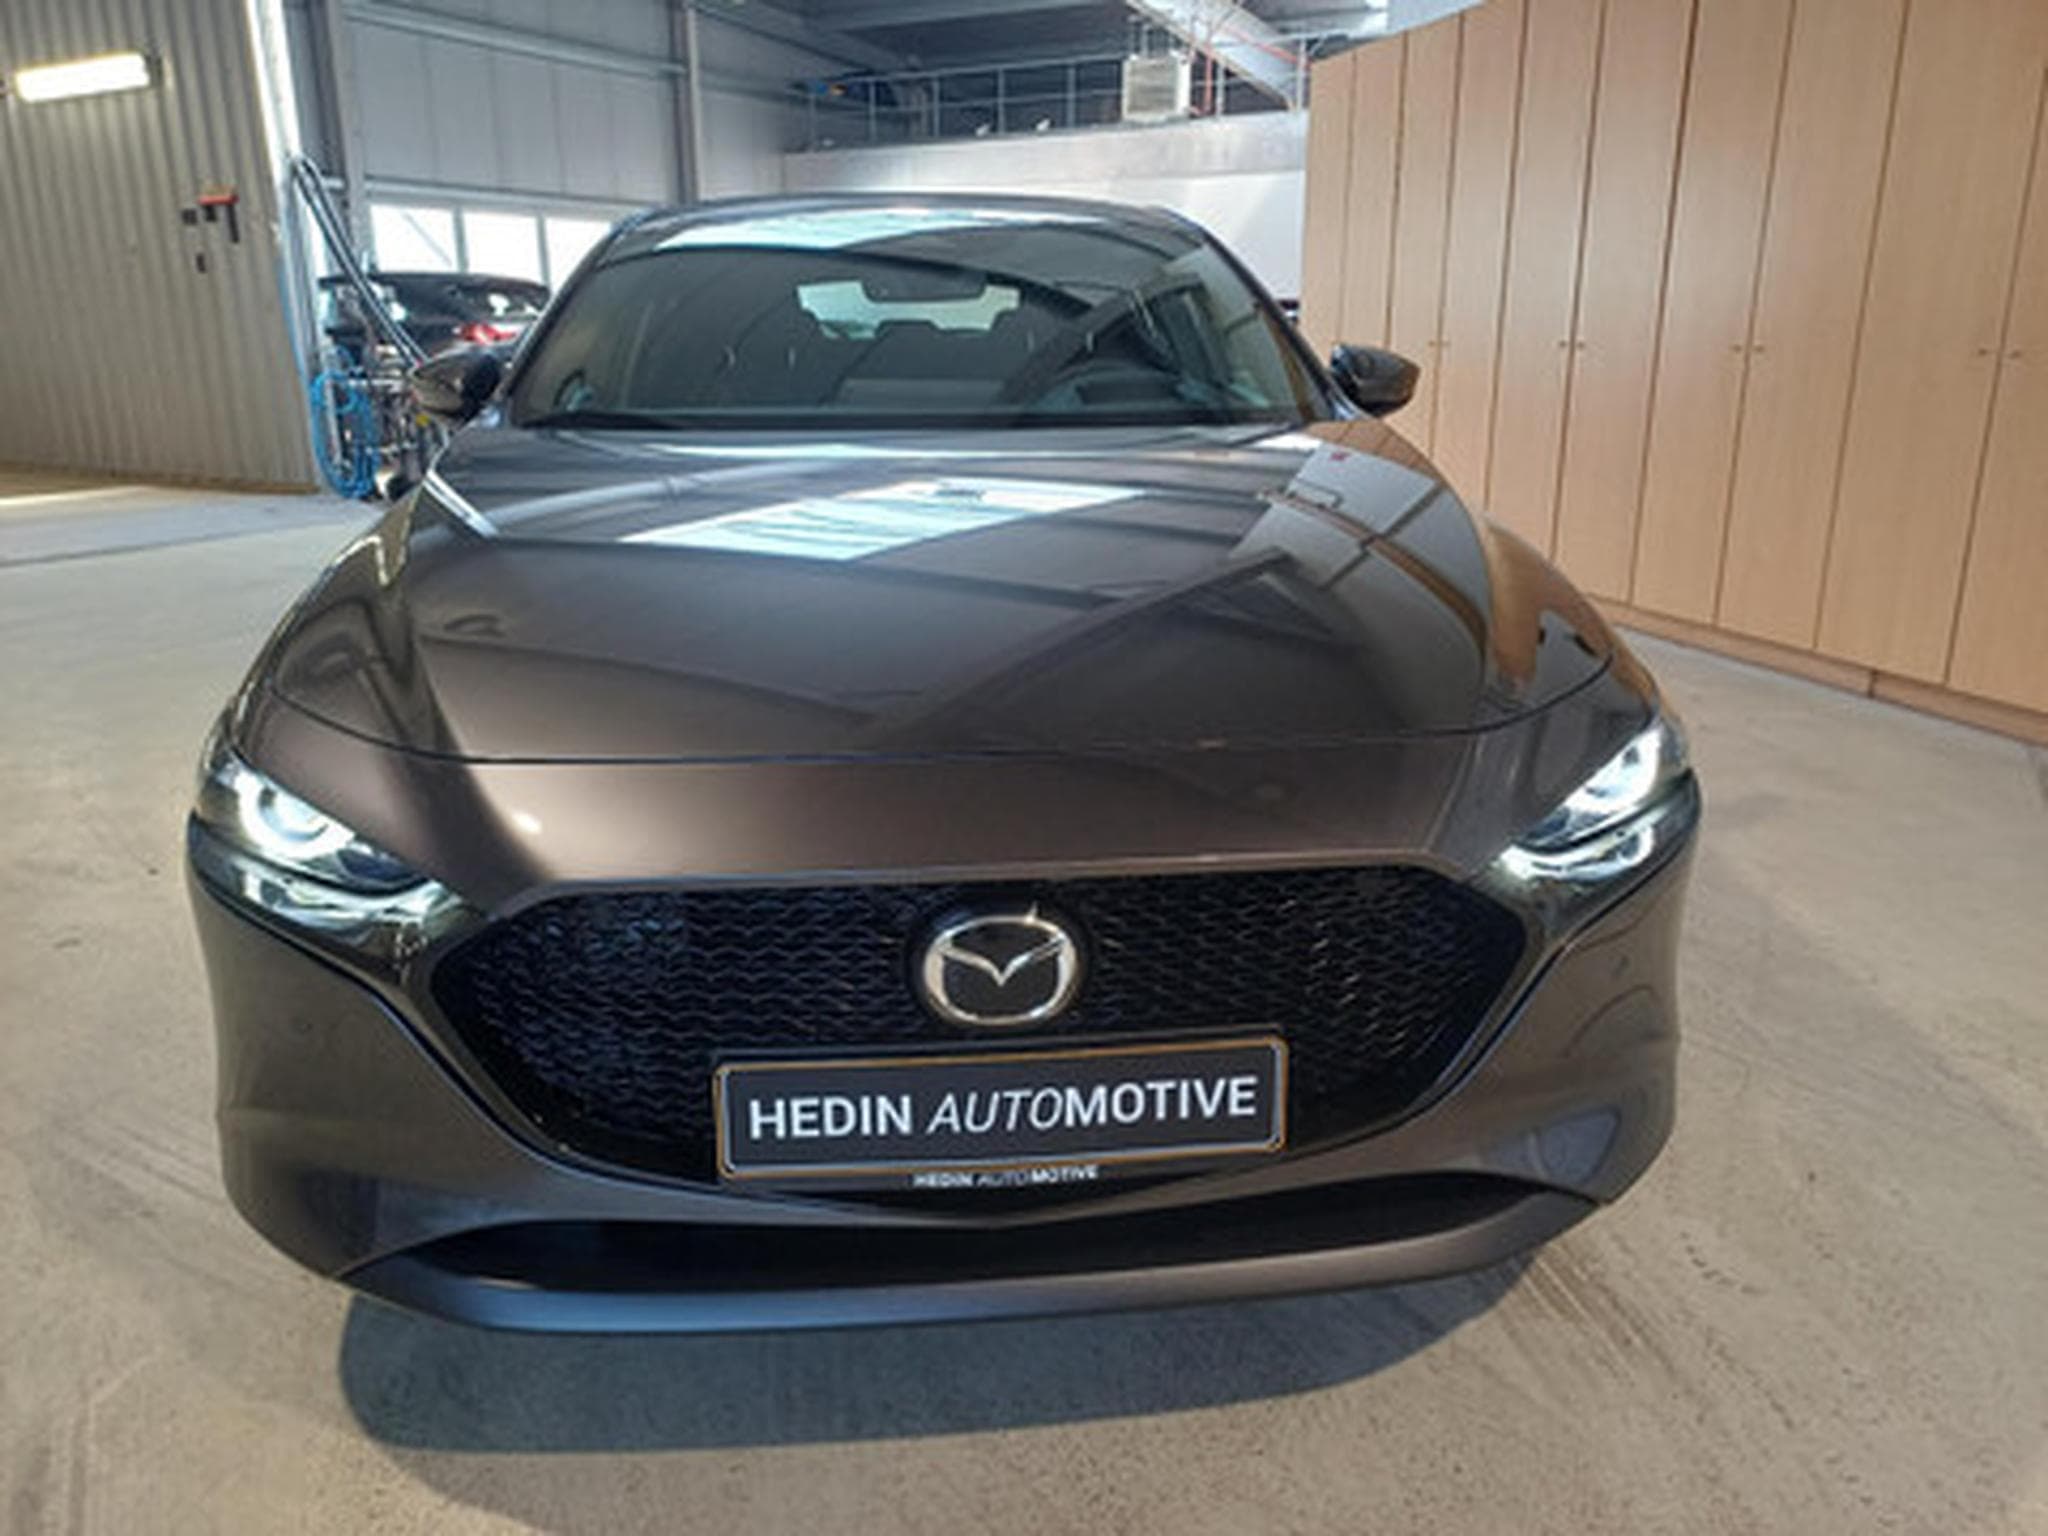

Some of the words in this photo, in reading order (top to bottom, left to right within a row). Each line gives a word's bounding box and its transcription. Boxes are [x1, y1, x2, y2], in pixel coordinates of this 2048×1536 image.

[749, 1095, 912, 1140] HEDIN
[926, 1075, 1259, 1135] AUTOMOTIVE
[913, 1173, 974, 1188] HEDIN
[975, 1164, 1099, 1187] AUTOMOTIVE
